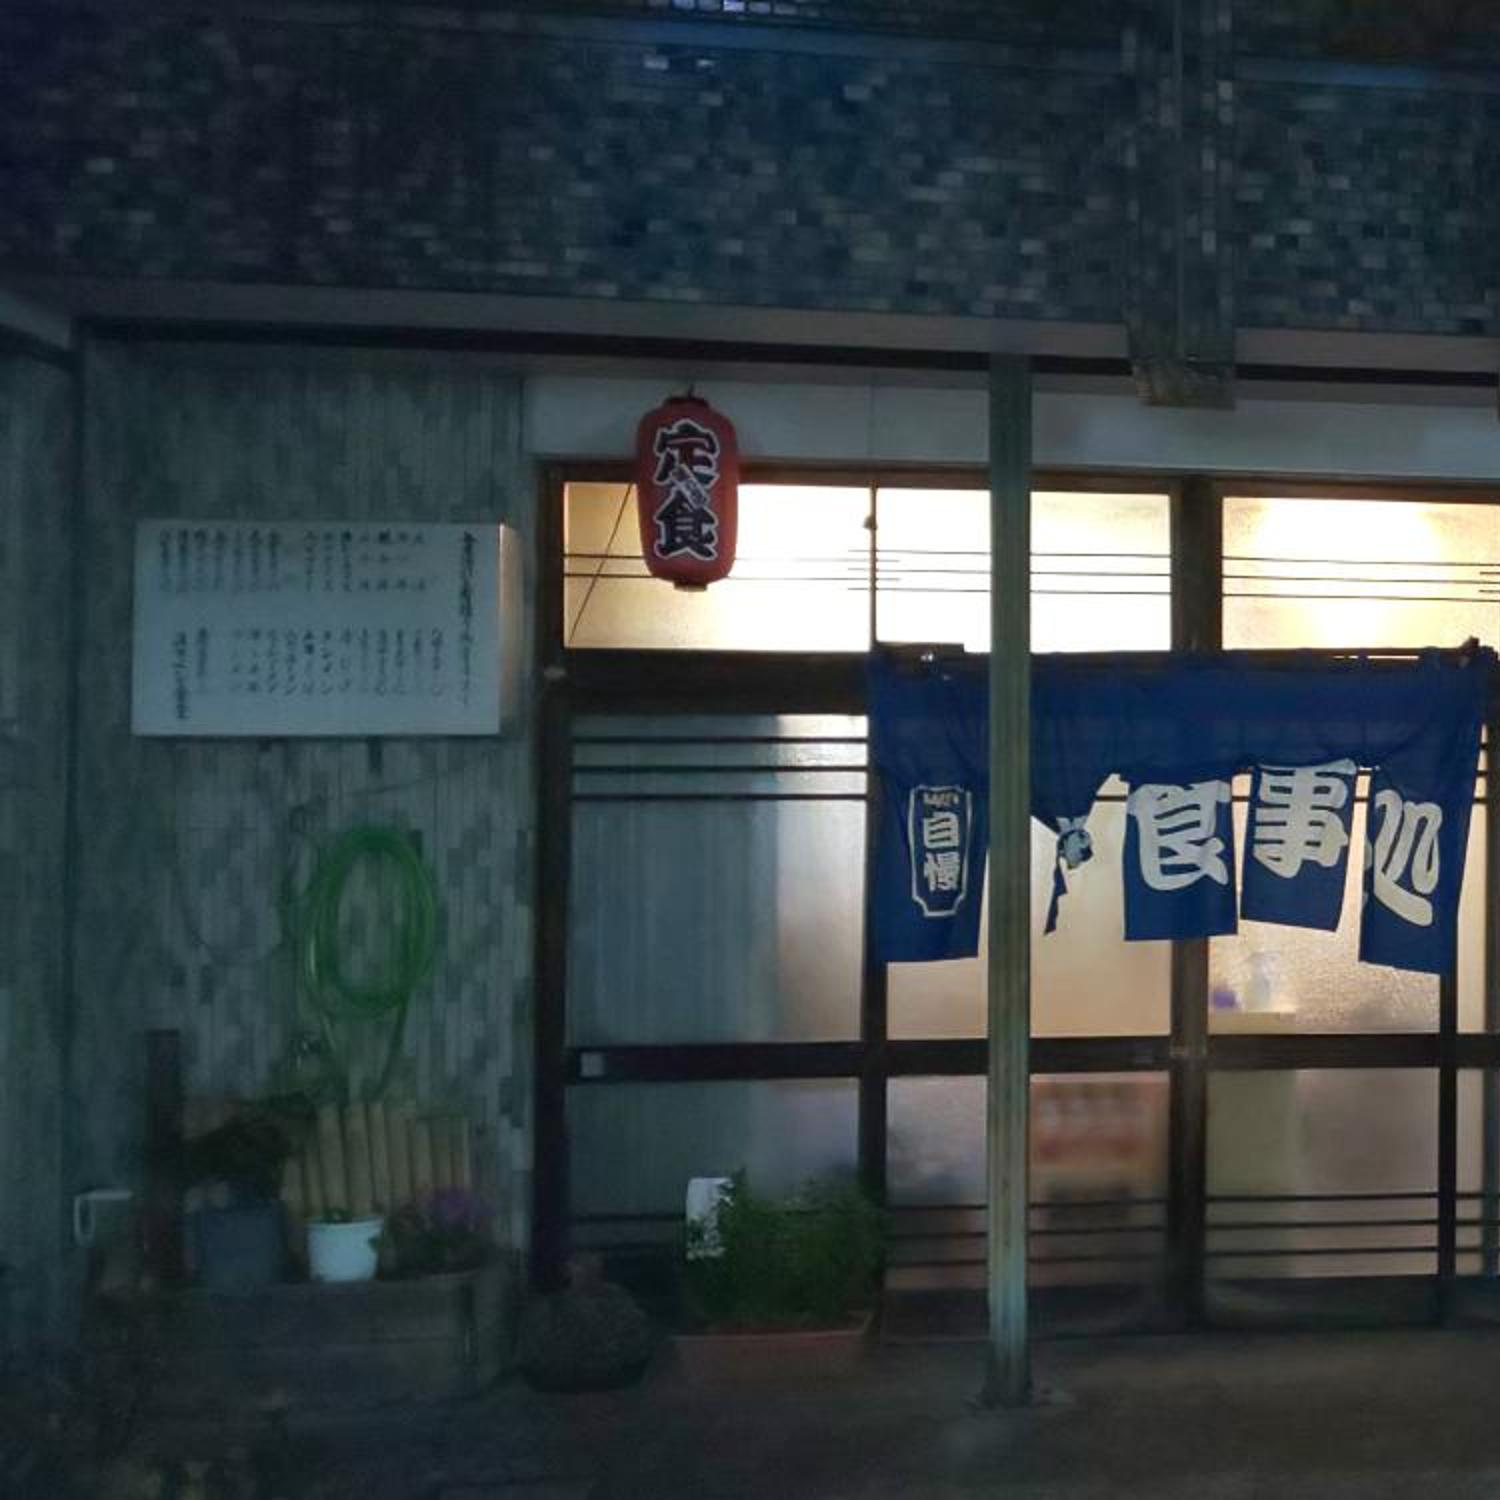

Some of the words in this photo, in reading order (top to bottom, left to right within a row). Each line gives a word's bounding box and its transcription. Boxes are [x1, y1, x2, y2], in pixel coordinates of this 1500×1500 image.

[654, 418, 720, 559] 定食
[1056, 757, 1444, 927] 食事処
